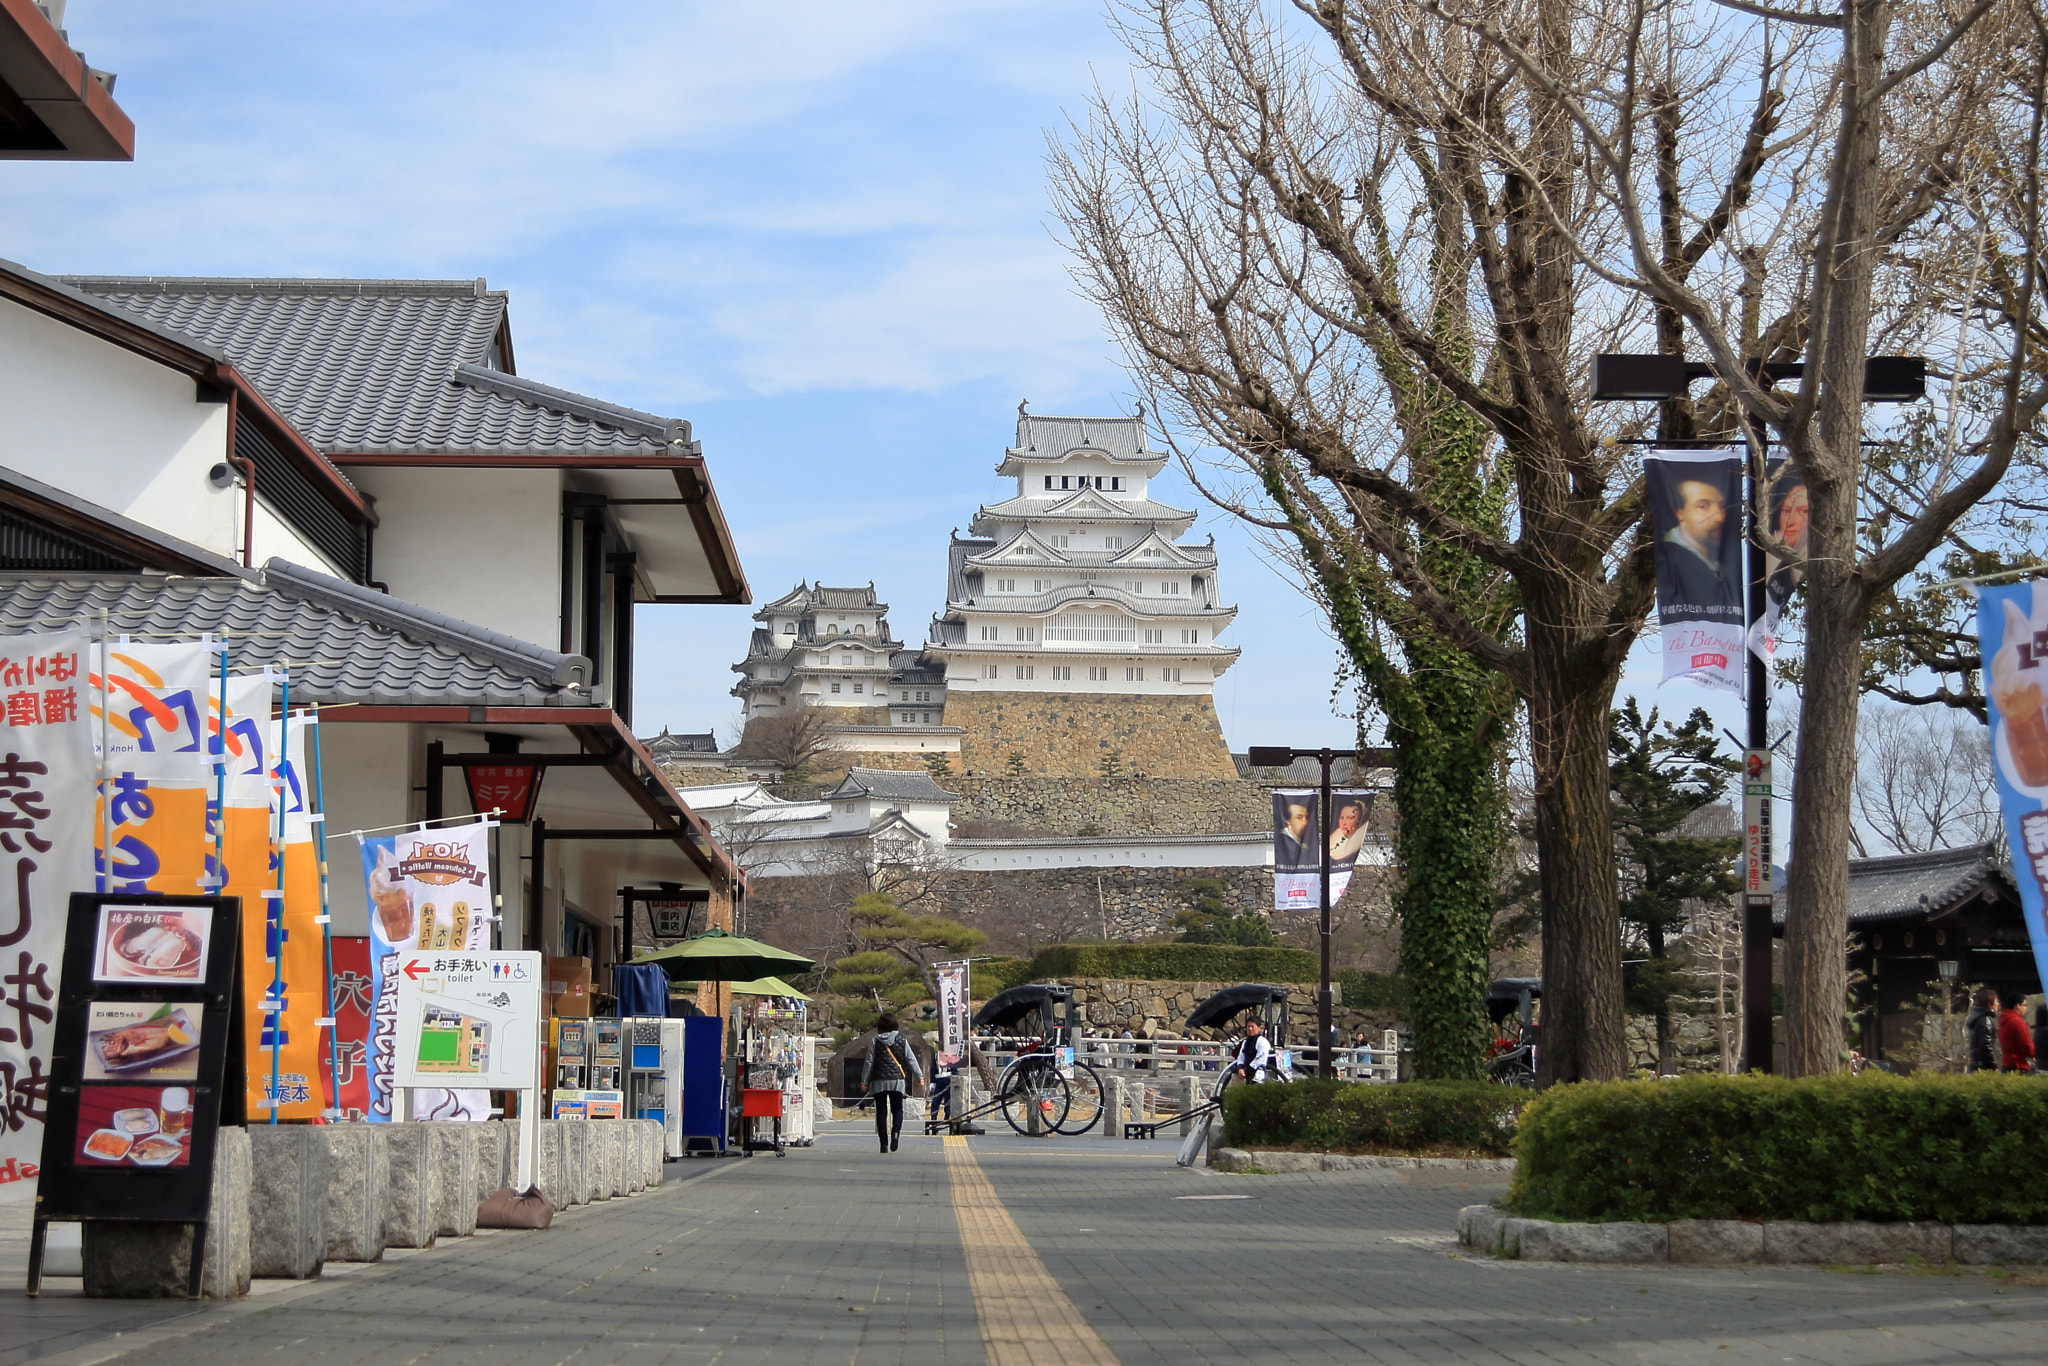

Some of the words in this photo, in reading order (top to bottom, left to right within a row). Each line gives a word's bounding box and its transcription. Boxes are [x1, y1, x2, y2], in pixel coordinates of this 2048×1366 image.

[477, 785, 526, 801] ミラノ
[1748, 825, 1759, 891] ゆっくり走行
[434, 958, 488, 972] お手洗い
[447, 974, 473, 982] toilet
